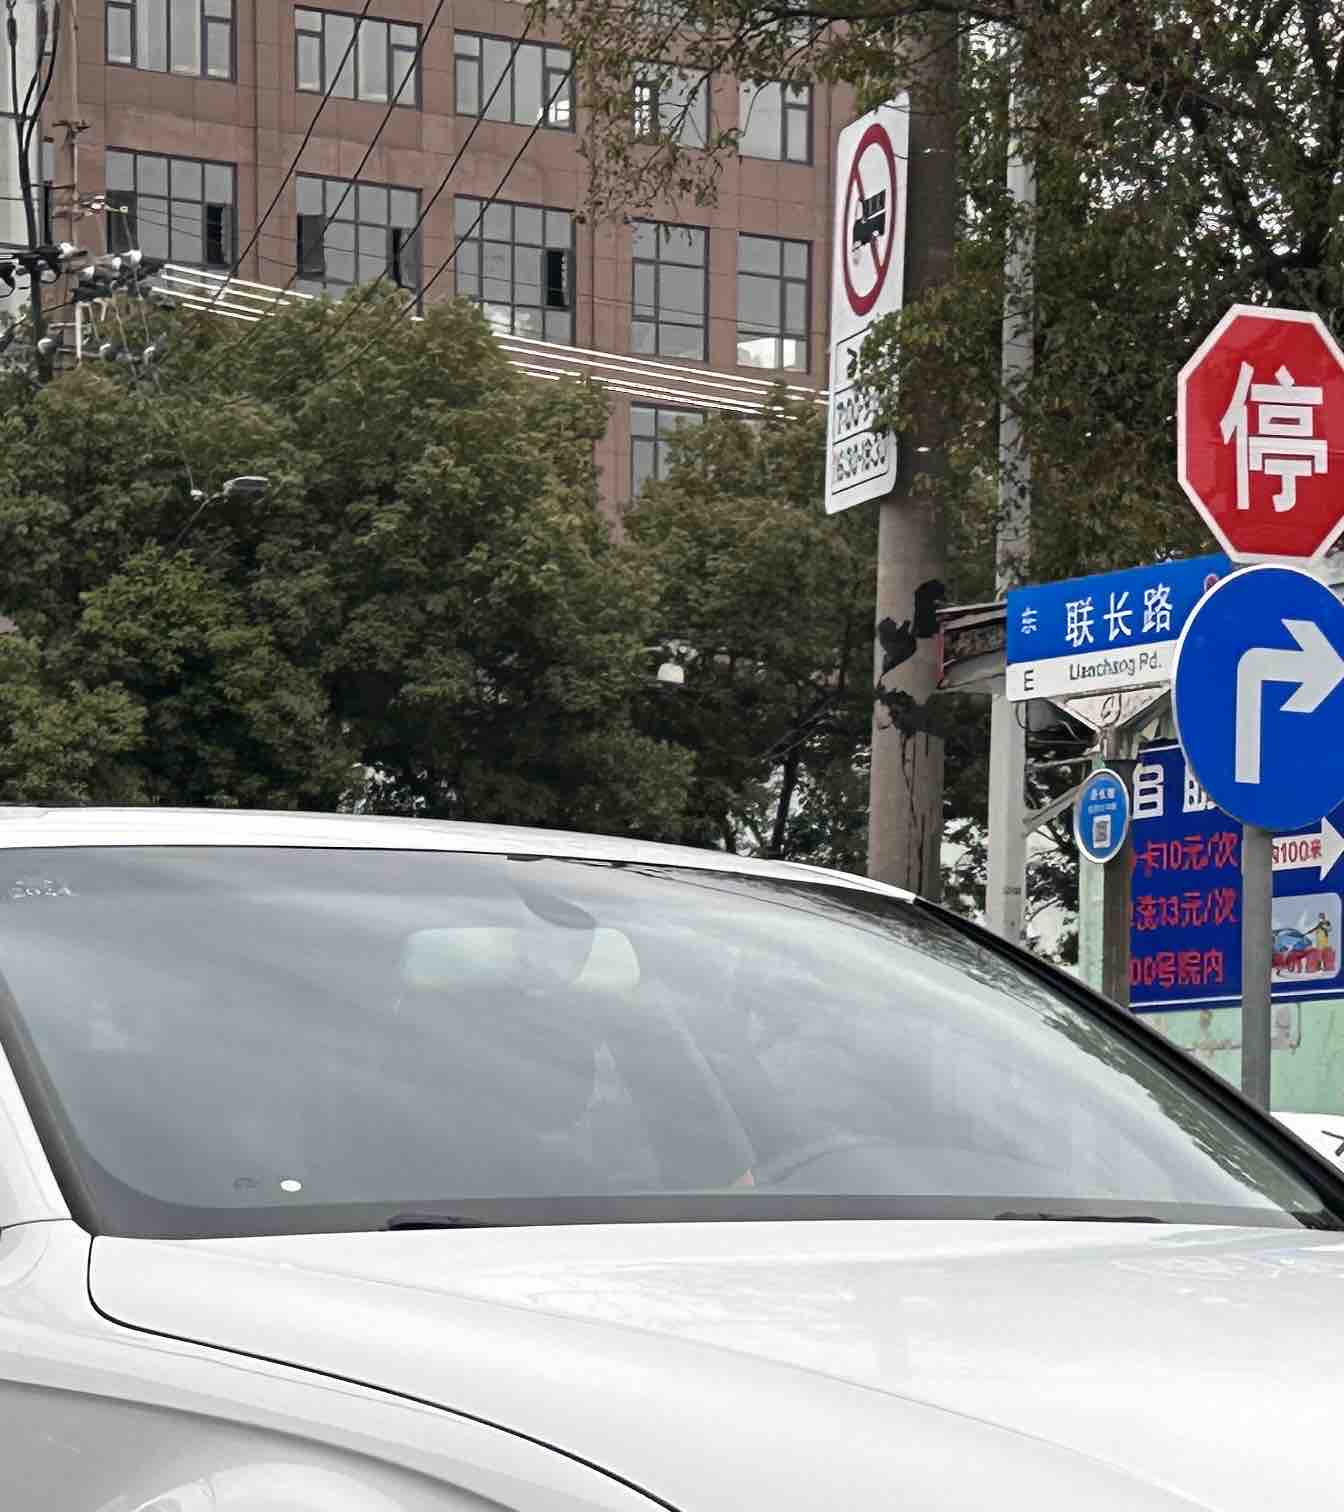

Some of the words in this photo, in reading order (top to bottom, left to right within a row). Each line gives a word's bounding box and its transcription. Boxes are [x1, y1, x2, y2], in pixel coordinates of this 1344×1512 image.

[1220, 361, 1328, 512] 停
[1020, 606, 1038, 635] 东
[1064, 583, 1174, 648] 联长路
[1023, 669, 1035, 692] E
[1138, 651, 1163, 672] Rd.
[1130, 831, 1239, 878] 卡10元/次
